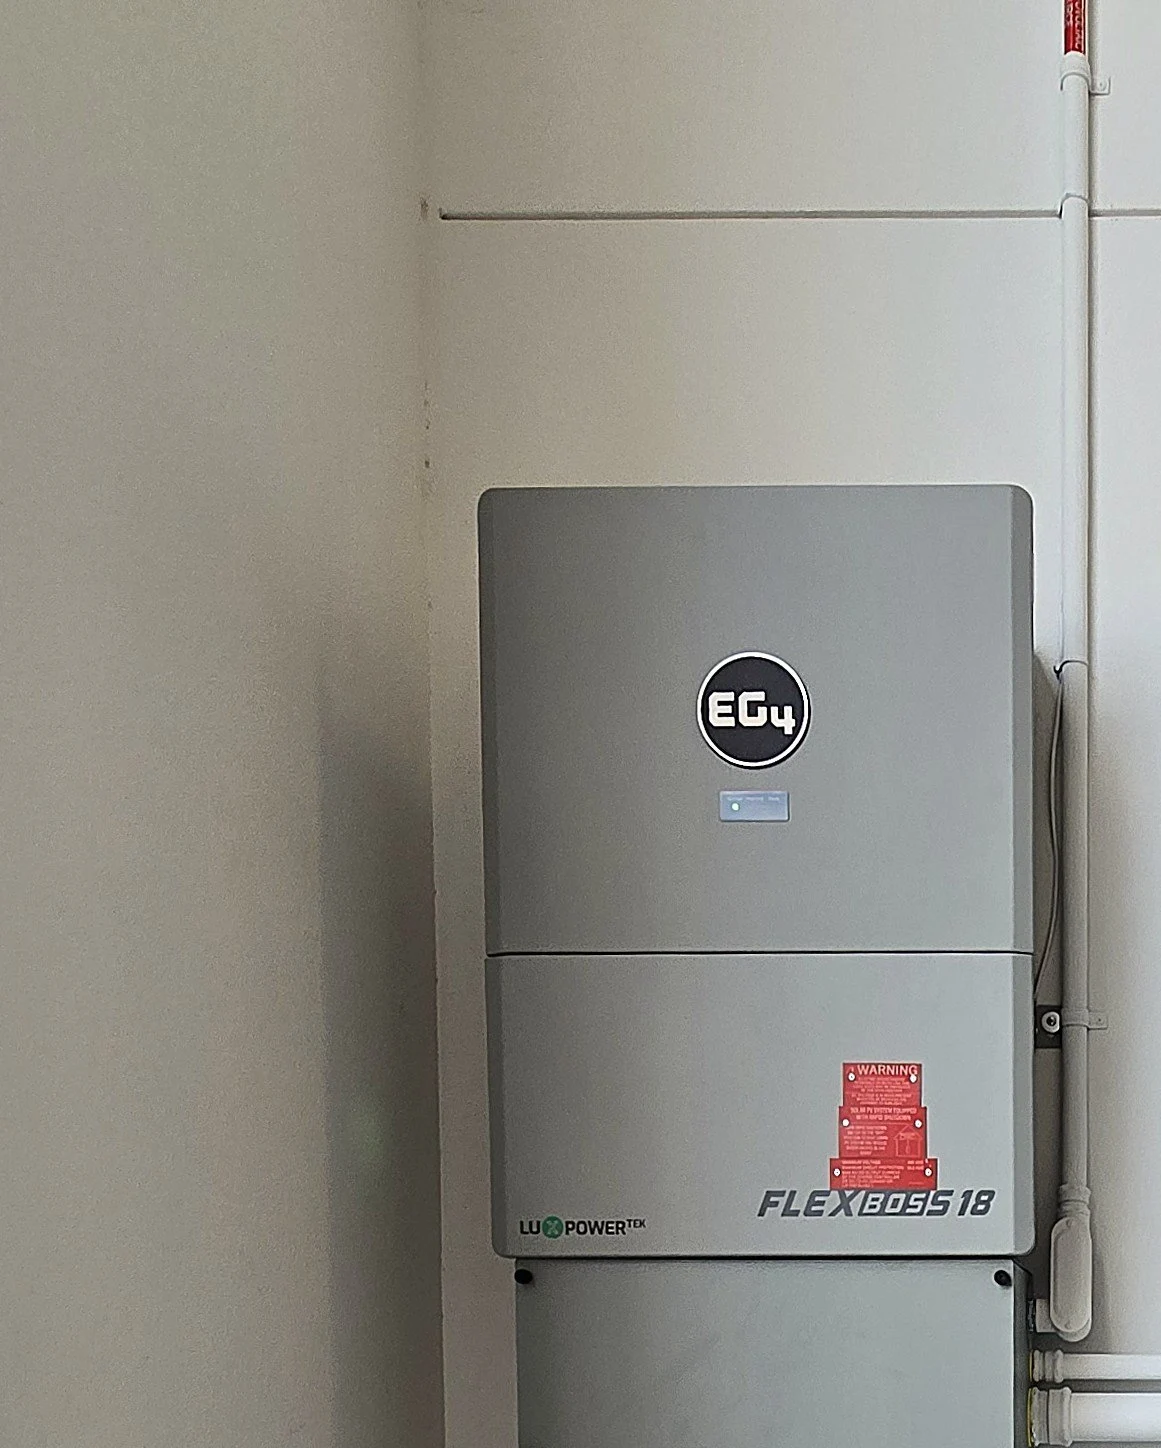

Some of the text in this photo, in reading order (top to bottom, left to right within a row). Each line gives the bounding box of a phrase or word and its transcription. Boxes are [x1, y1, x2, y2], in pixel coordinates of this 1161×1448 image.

[708, 691, 796, 735] EG4
[857, 1064, 918, 1075] WARNING
[957, 1189, 996, 1217] 18
